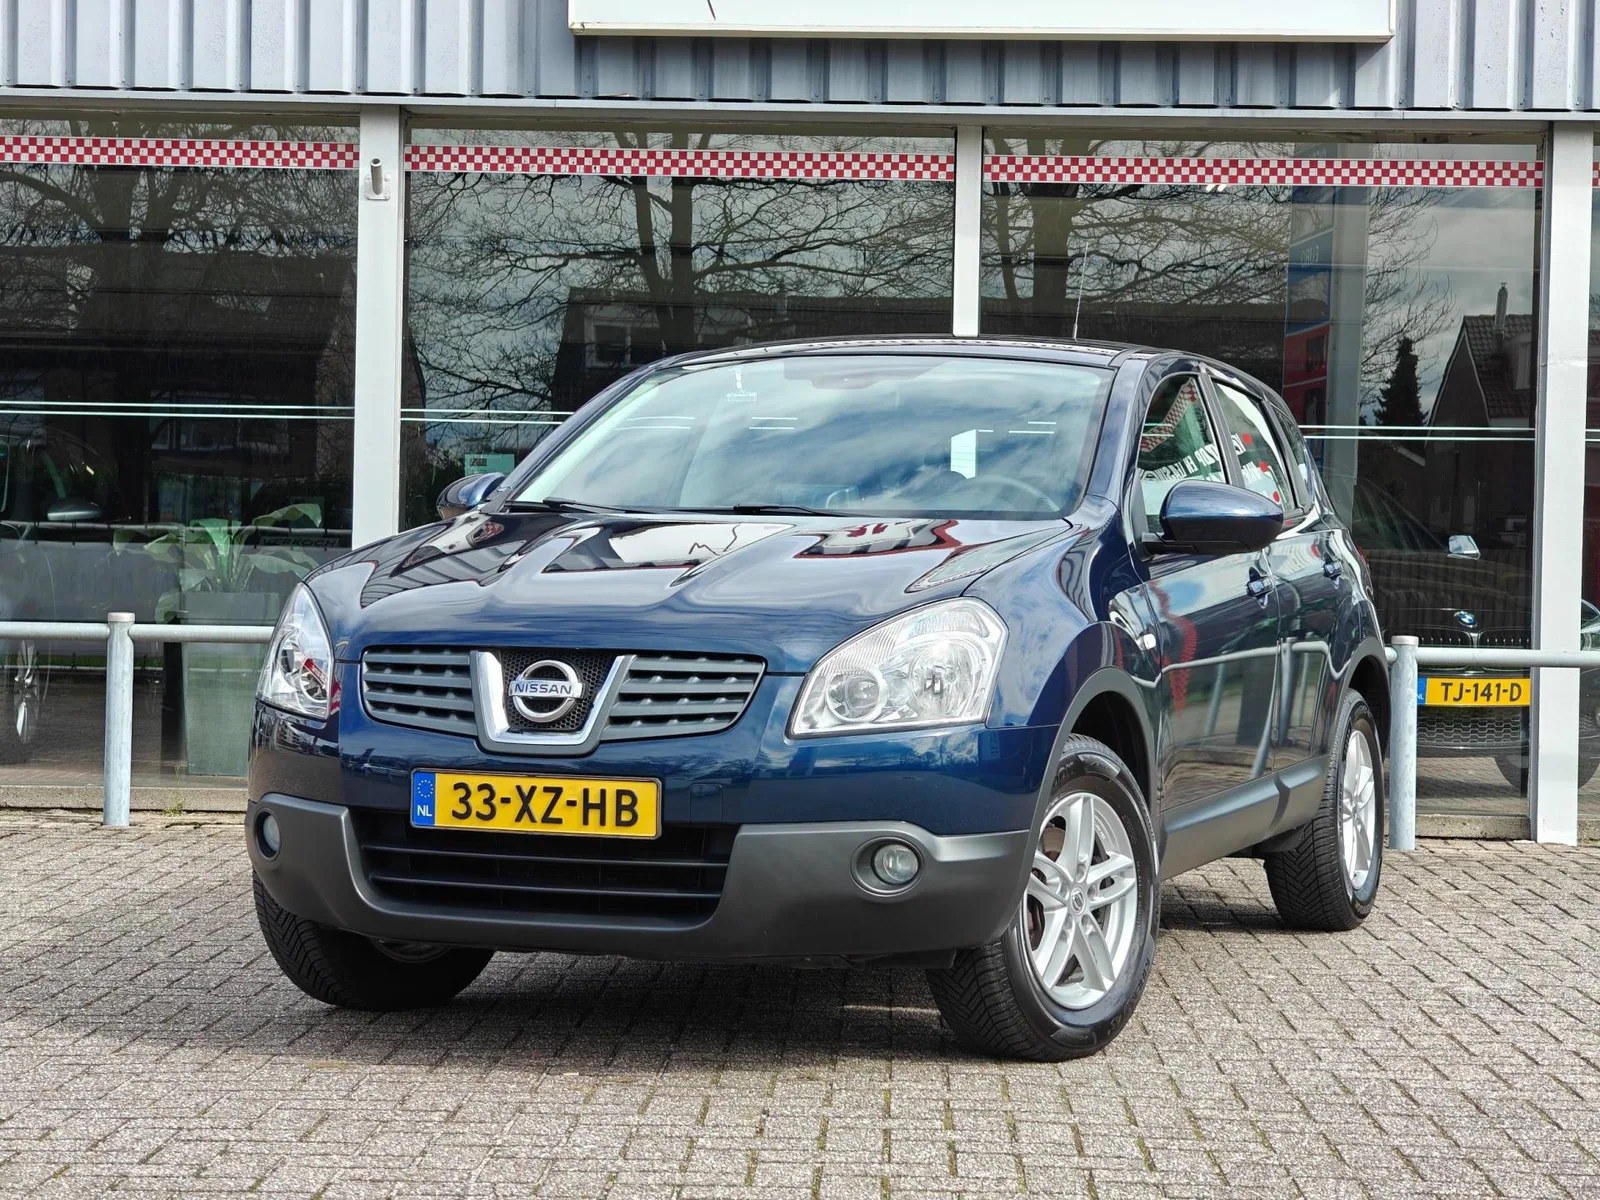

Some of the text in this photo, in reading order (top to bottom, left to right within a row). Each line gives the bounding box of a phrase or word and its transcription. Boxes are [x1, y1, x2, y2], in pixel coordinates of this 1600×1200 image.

[514, 683, 572, 695] NISSAN
[1440, 682, 1522, 702] TJ-141-D
[417, 804, 433, 817] NL
[451, 781, 639, 828] 33-XZ-HB
